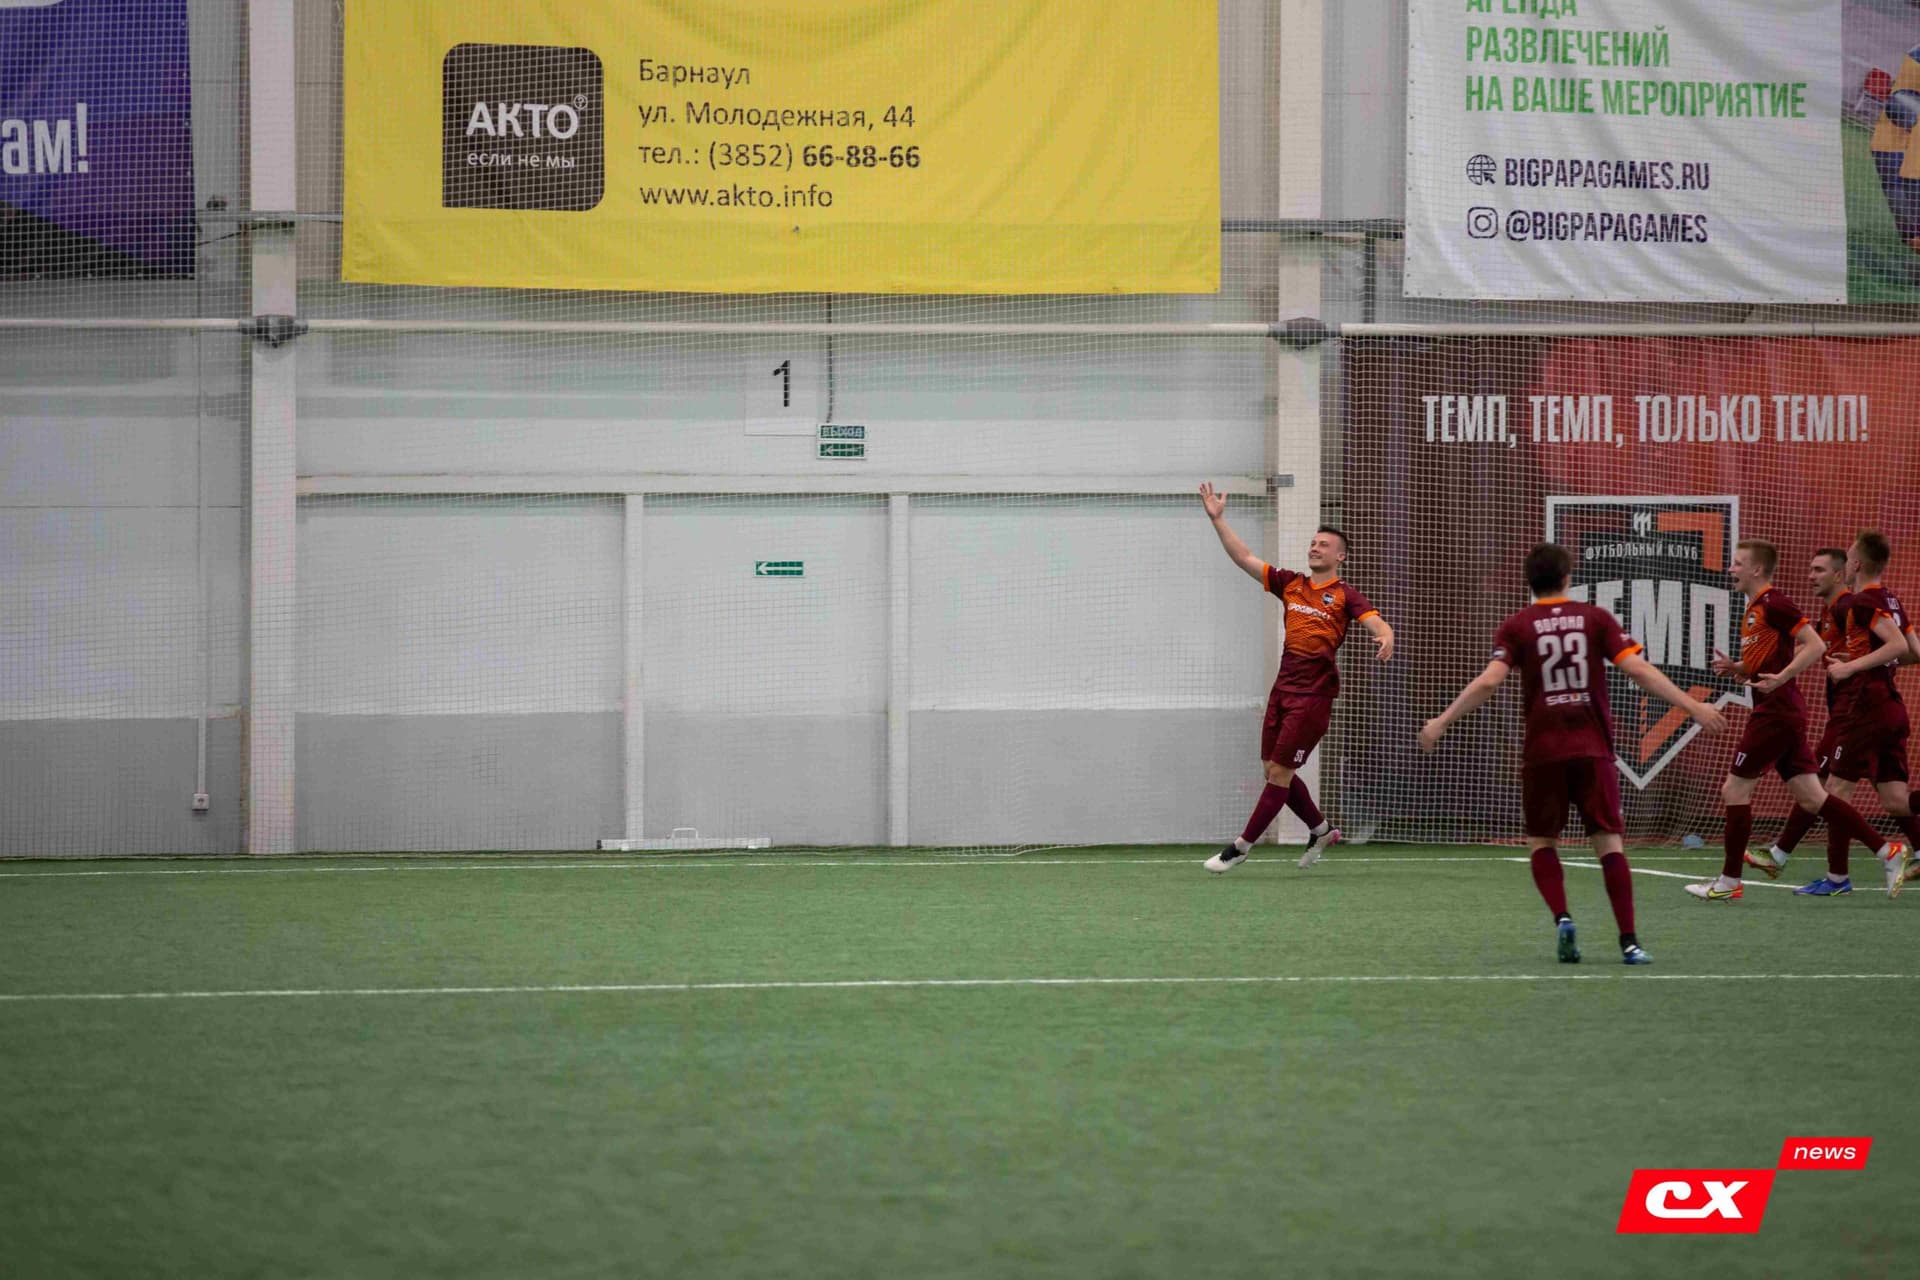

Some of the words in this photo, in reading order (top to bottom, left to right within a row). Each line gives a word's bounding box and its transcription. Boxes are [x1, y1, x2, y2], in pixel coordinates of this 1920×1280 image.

[1466, 25, 1670, 67] РАЗВЛЕЧЕНИЙ
[639, 58, 750, 89] Барнаул
[1465, 75, 1503, 112] НА
[1512, 76, 1594, 113] ВАШЕ
[1601, 79, 1807, 118] МЕРОПРИЯТИЕ
[638, 104, 675, 128] ул.
[686, 101, 873, 132] Молодежная,
[883, 105, 916, 128] 44
[467, 152, 512, 166] если
[518, 154, 541, 167] не
[546, 155, 575, 168] мы
[638, 145, 699, 165] тел.:
[709, 141, 793, 172] (3852)
[803, 144, 920, 168] 66-88-66
[1505, 158, 1710, 190] BIGPAPAGAMES.RU
[639, 184, 833, 208] www.akto.info
[1505, 210, 1709, 243] @BIGPAPAGAMES
[772, 360, 791, 407] 1
[1422, 395, 1517, 449] ТЕМП,
[1528, 395, 1624, 449] ТЕМП,
[1635, 395, 1761, 442] ТОЛЬКО
[1772, 395, 1869, 442] ТЕМП!
[1585, 540, 1663, 560] ФУТБОЛЬНЫЙ
[1667, 544, 1698, 560] КЛУБ
[1537, 632, 1589, 692] 23
[1735, 751, 1747, 767] 17
[1834, 745, 1843, 760] 6
